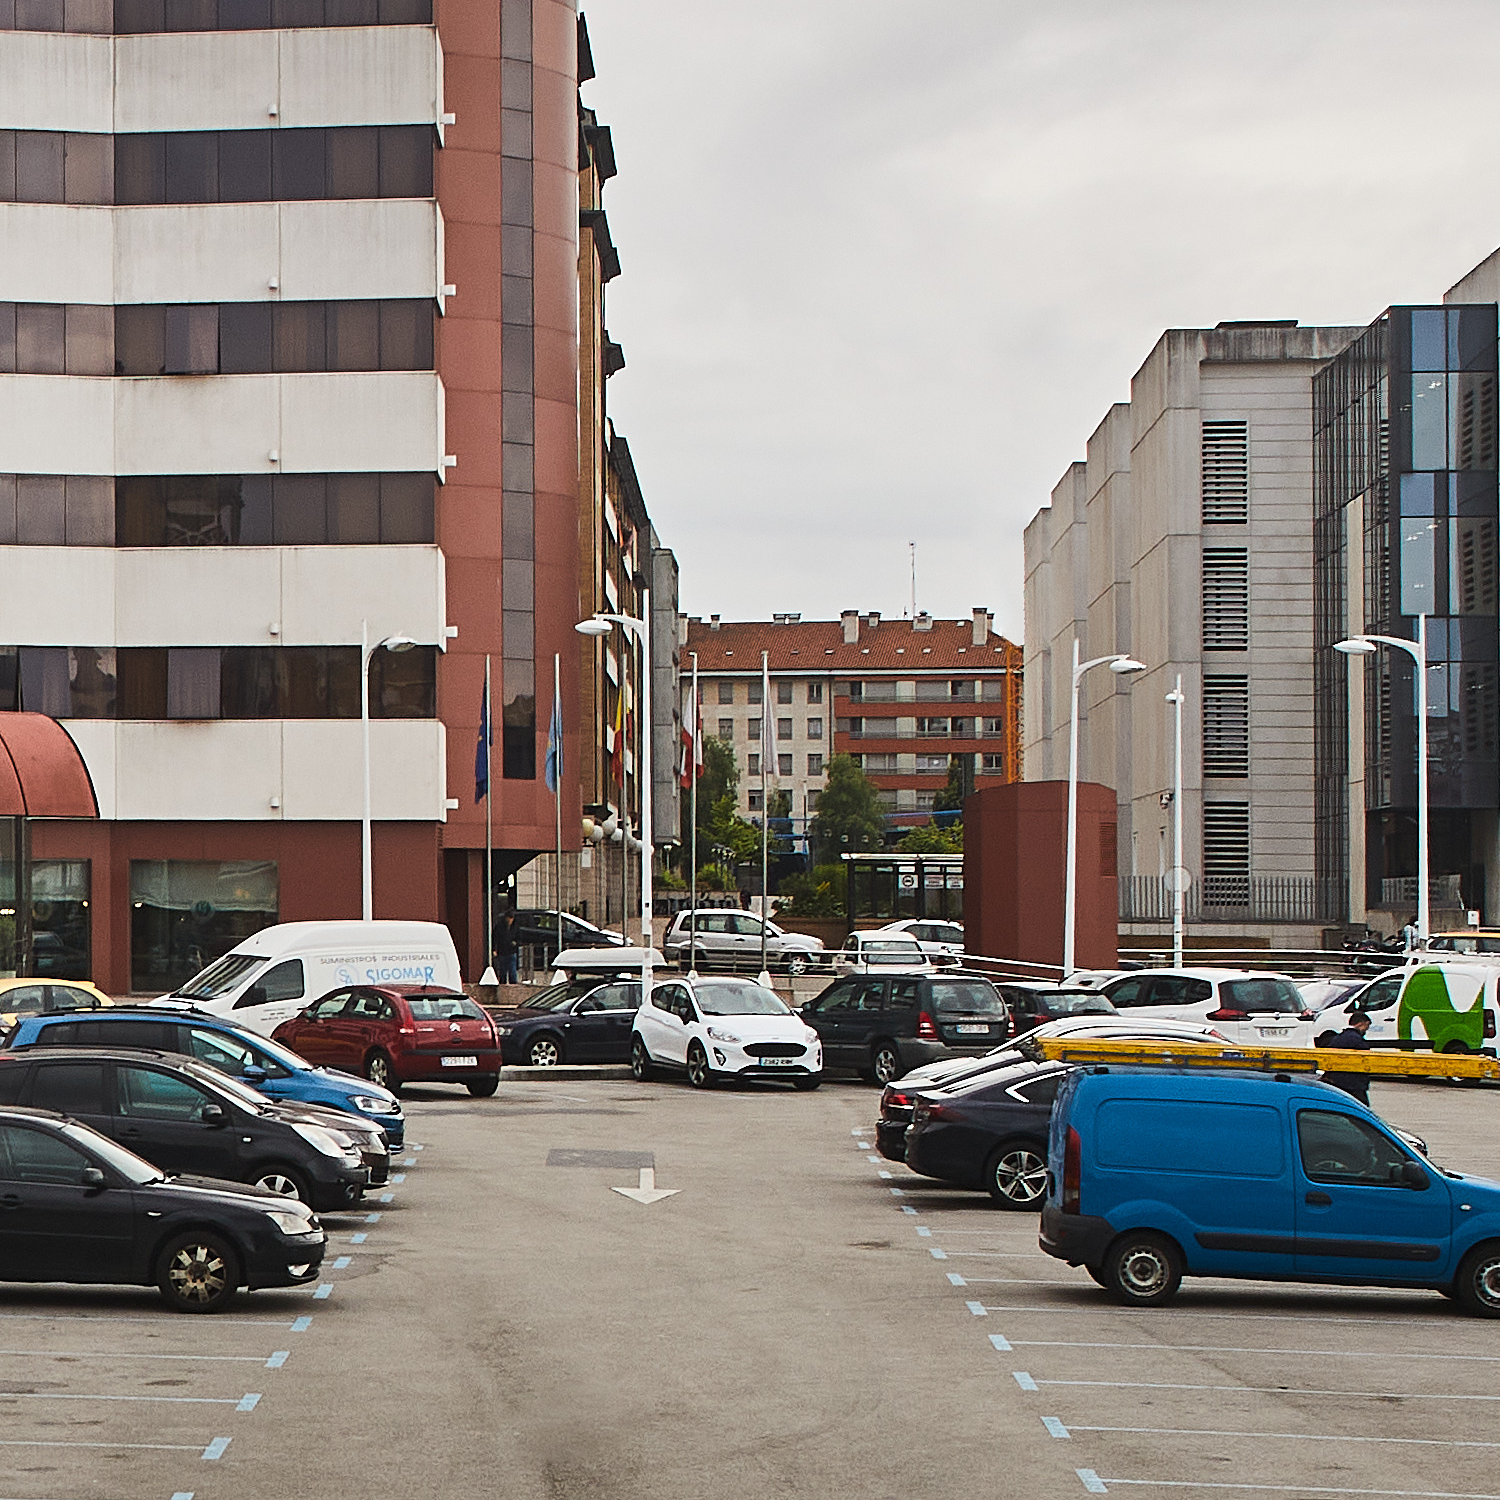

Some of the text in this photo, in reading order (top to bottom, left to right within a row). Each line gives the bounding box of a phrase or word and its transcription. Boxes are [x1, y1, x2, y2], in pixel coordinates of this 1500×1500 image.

[320, 953, 441, 965] SUMINISTROS INDUSTRIALES
[366, 965, 435, 985] SIGOMAR
